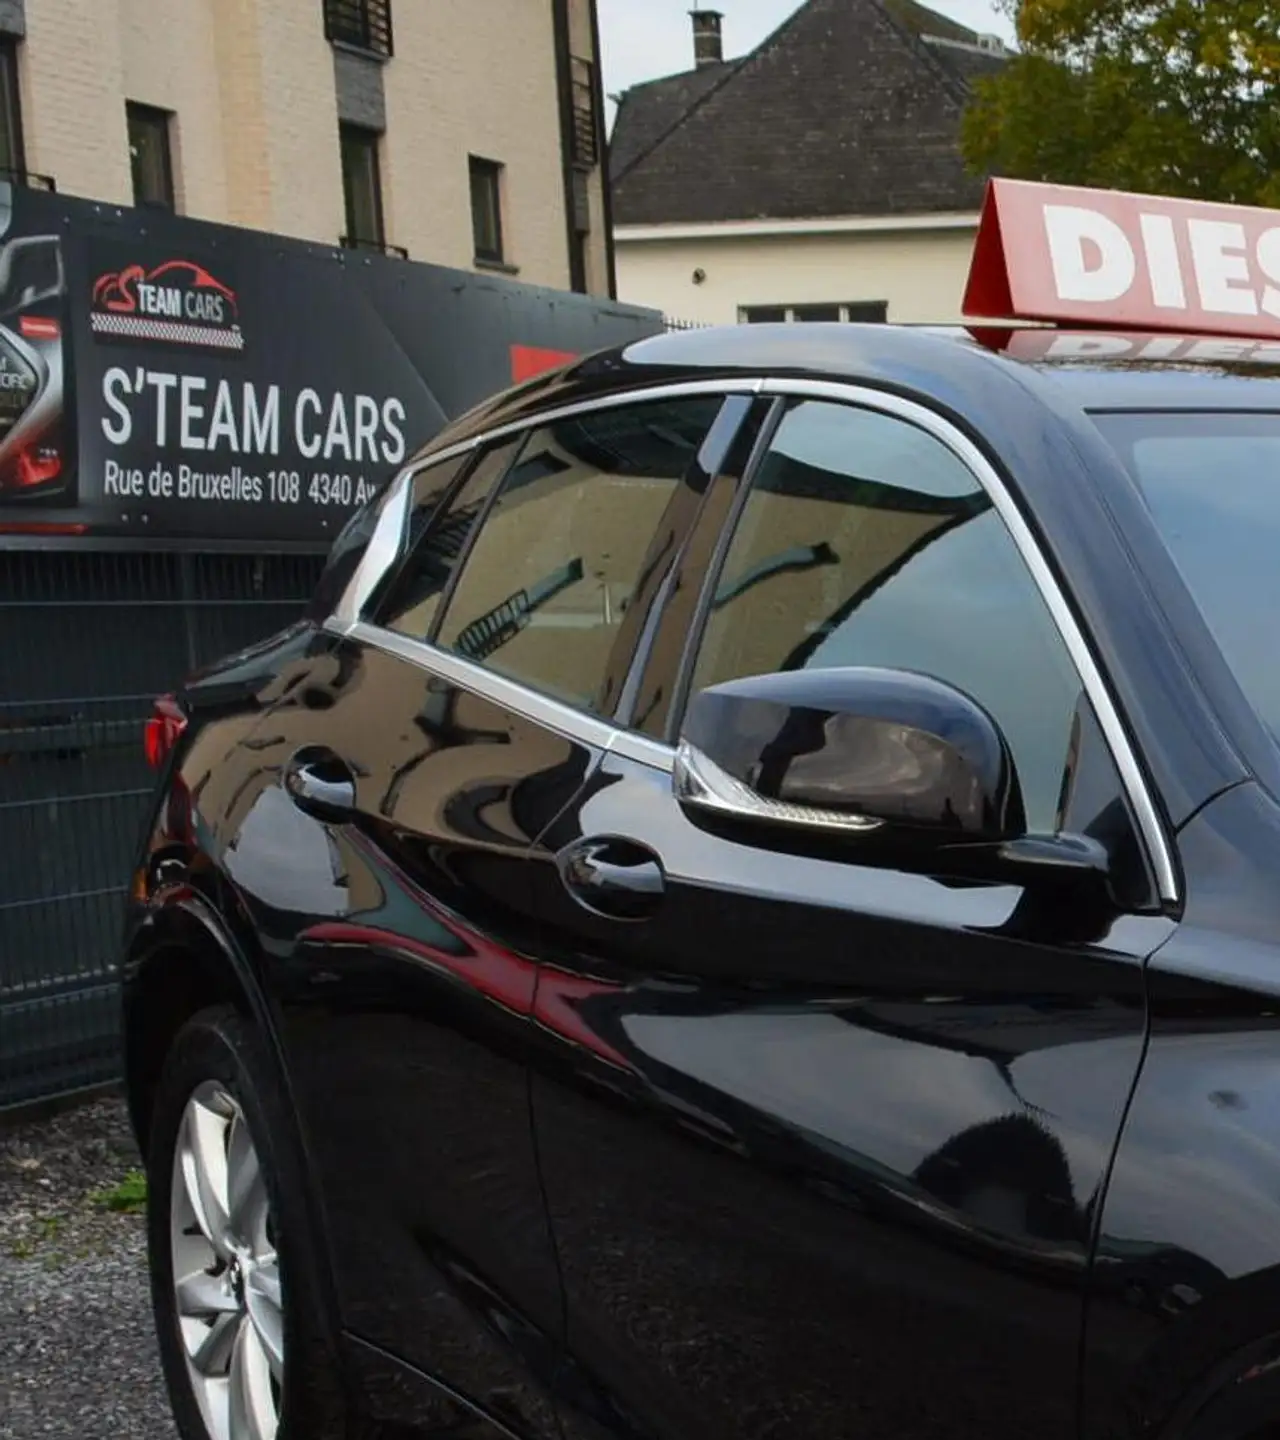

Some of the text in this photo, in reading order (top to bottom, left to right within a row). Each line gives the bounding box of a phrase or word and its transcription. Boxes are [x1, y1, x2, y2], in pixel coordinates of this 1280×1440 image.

[185, 291, 224, 323] CARS
[102, 366, 280, 455] S'TEAM
[295, 388, 406, 464] CARS
[104, 460, 144, 495] Rue
[148, 462, 173, 497] de
[177, 464, 263, 501] Bruxelles
[268, 470, 300, 504] 108
[307, 472, 351, 505] 4340
